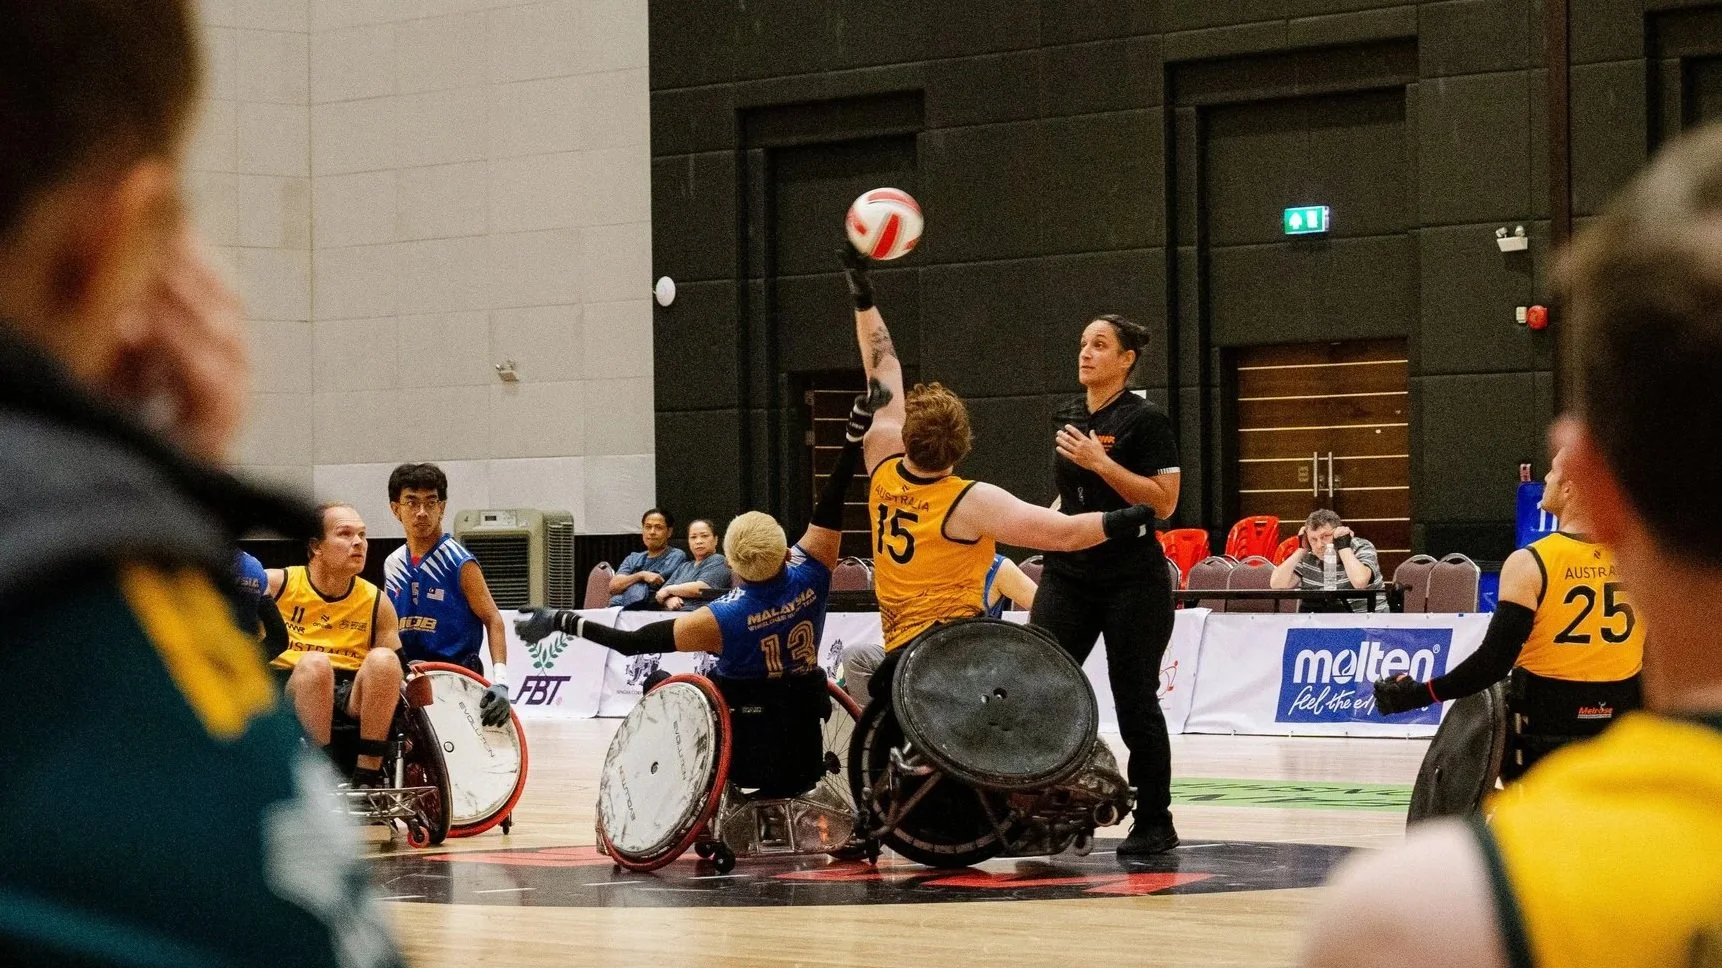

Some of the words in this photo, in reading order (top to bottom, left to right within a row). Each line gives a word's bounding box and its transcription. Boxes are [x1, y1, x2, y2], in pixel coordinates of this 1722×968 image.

[875, 484, 929, 511] AUSTRALIA
[877, 503, 919, 564] 15
[1565, 566, 1617, 580] AUSTRA
[291, 605, 305, 624] 11
[747, 588, 815, 625] MALAYSIA
[1553, 582, 1635, 643] 25
[760, 620, 817, 679] 13
[1293, 641, 1435, 684] molten
[509, 675, 572, 706] FBT
[1288, 686, 1331, 715] feel
[1326, 690, 1355, 712] the
